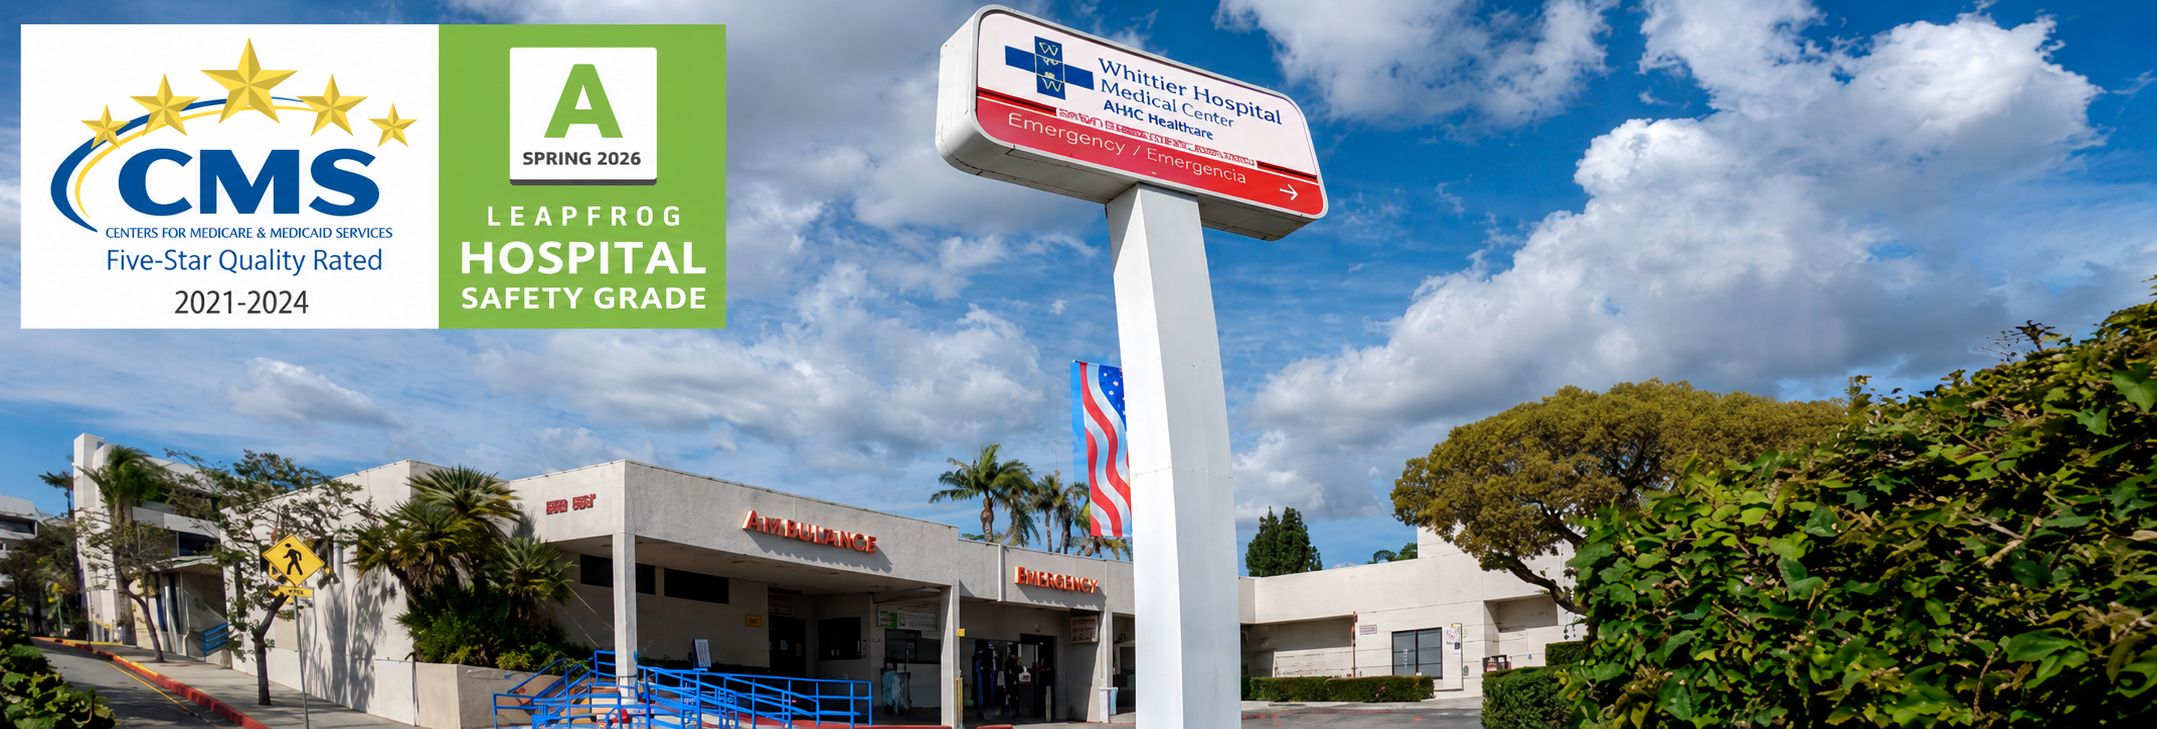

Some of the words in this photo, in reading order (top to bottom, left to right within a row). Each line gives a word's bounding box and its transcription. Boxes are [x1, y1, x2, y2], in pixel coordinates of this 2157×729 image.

[1098, 57, 1187, 96] Whittier
[1194, 86, 1283, 124] Hospital
[1101, 79, 1178, 112] Medical
[1182, 103, 1235, 127] Center
[1008, 112, 1126, 156] Emergency
[1147, 148, 1247, 184] Emergencia
[1148, 113, 1214, 140] Healthcare
[742, 510, 877, 554] AMBULANCE
[1015, 566, 1098, 593] EMERGENCY
